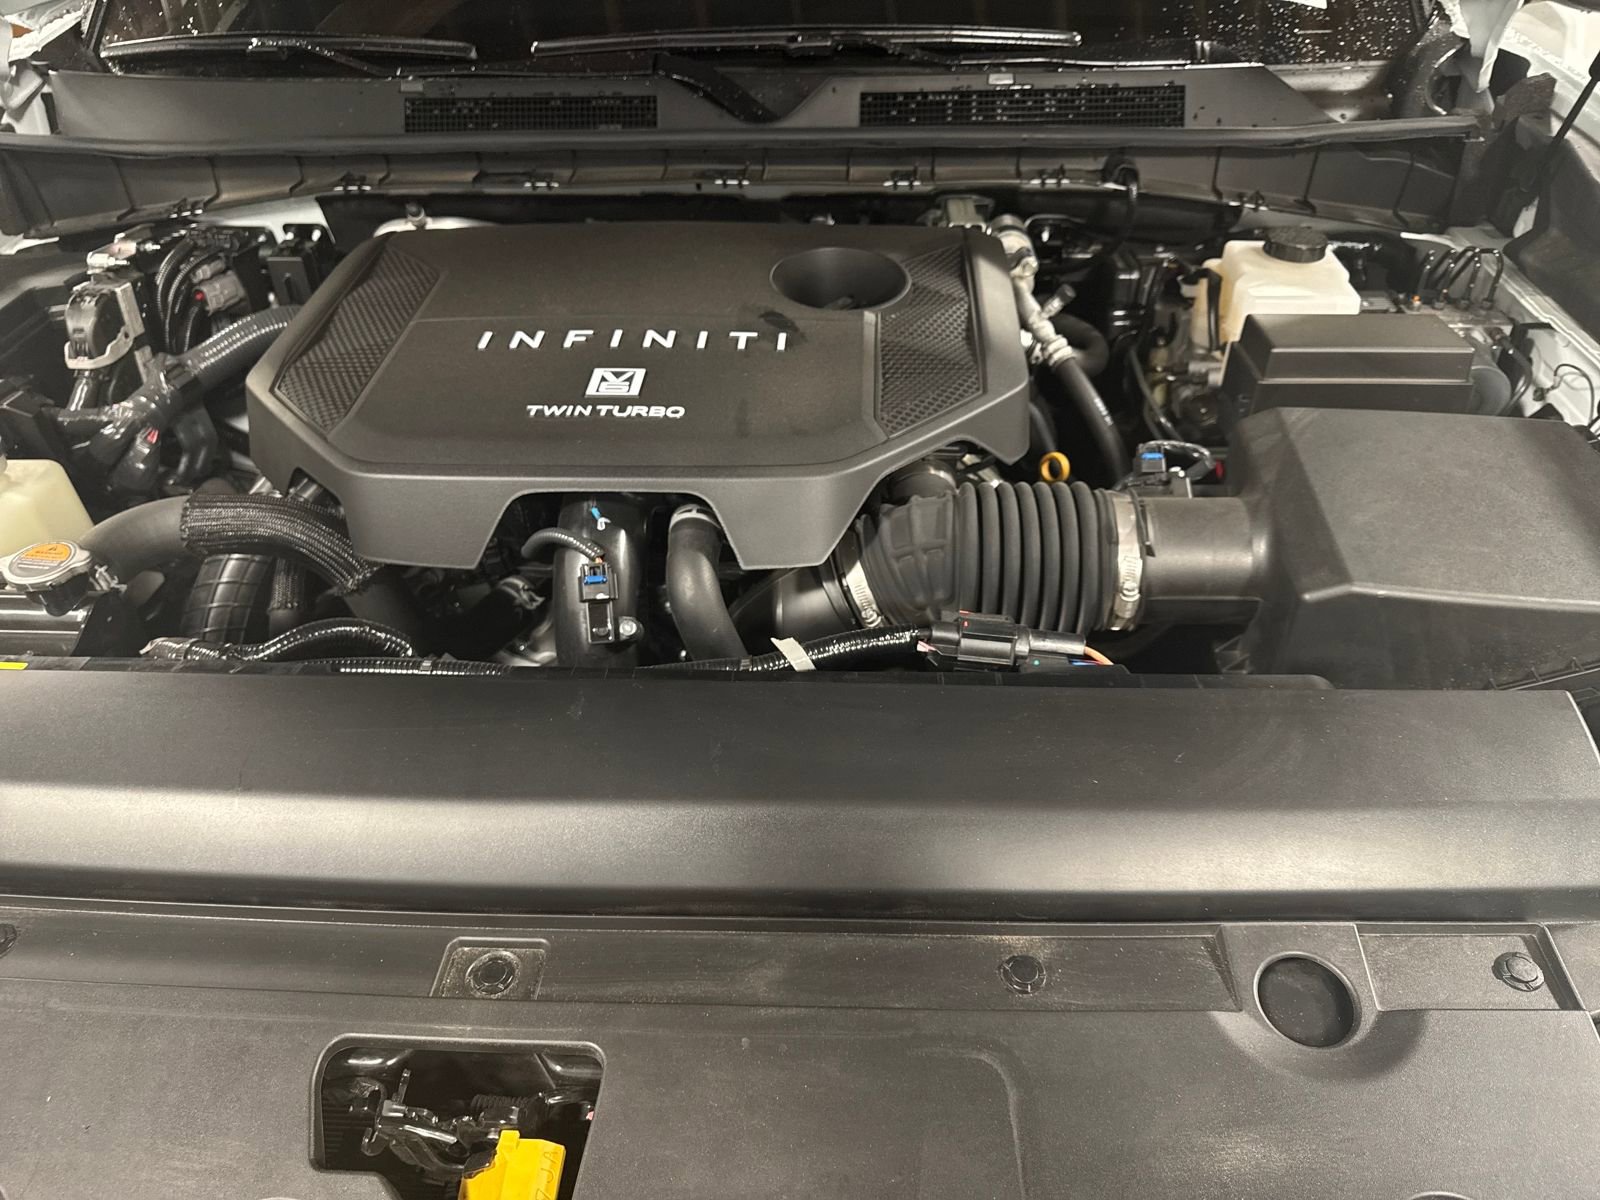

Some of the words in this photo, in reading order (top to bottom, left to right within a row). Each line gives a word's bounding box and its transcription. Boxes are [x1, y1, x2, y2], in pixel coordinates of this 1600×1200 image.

[477, 329, 787, 350] INFINITI
[526, 404, 593, 417] TWIN
[596, 404, 685, 418] TURBO
